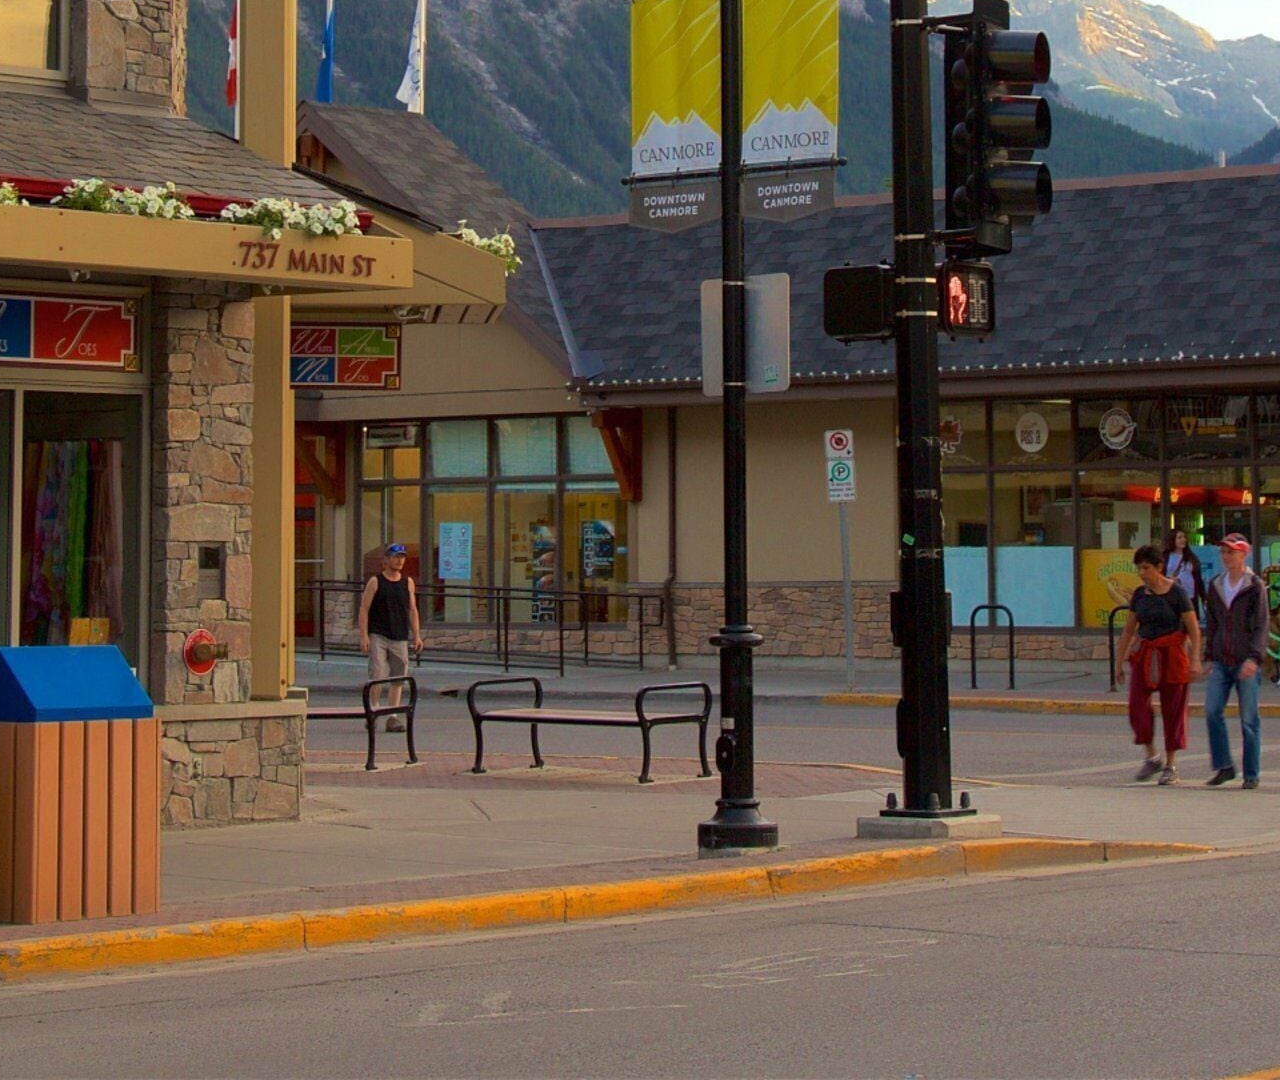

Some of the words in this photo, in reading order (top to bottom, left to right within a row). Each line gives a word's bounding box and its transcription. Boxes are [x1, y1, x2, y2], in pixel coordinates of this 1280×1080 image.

[751, 130, 830, 152] CANMORE
[639, 141, 716, 164] CANMORE
[756, 180, 820, 197] DOWNTOWN
[643, 192, 705, 207] DOWNTOWN
[762, 194, 813, 210] CANMORE
[648, 205, 699, 220] CANMORE
[239, 240, 281, 270] 737
[287, 248, 345, 275] MAIN
[352, 254, 377, 277] ST
